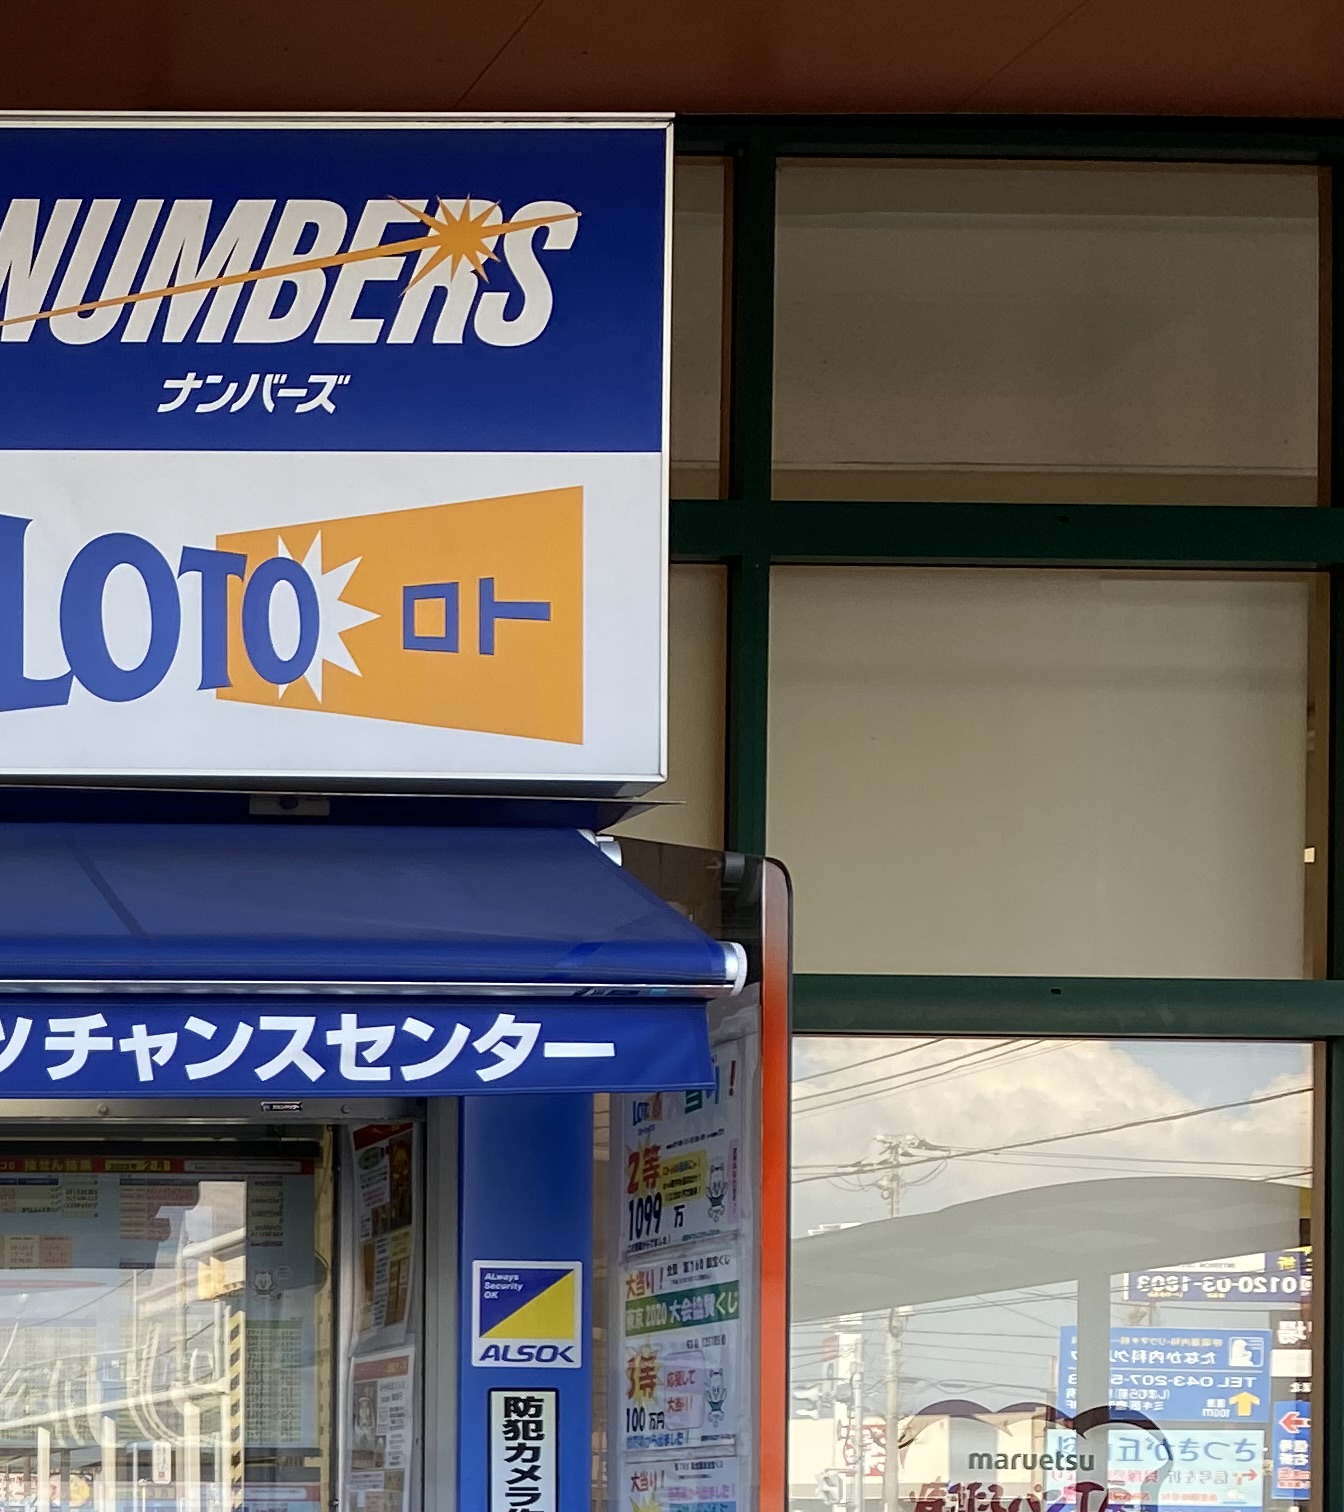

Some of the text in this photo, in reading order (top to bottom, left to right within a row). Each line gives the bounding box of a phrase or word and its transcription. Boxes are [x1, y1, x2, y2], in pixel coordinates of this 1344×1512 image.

[158, 372, 349, 414] ナンバーズ
[627, 1144, 661, 1194] 2等
[629, 1192, 662, 1241] 1099
[674, 1204, 685, 1228] 万
[484, 1282, 523, 1291] Security
[484, 1291, 498, 1299] OK
[479, 1344, 575, 1363] ALSOK
[626, 1407, 665, 1433] 100 万円
[968, 1452, 1095, 1471] maruetsu
